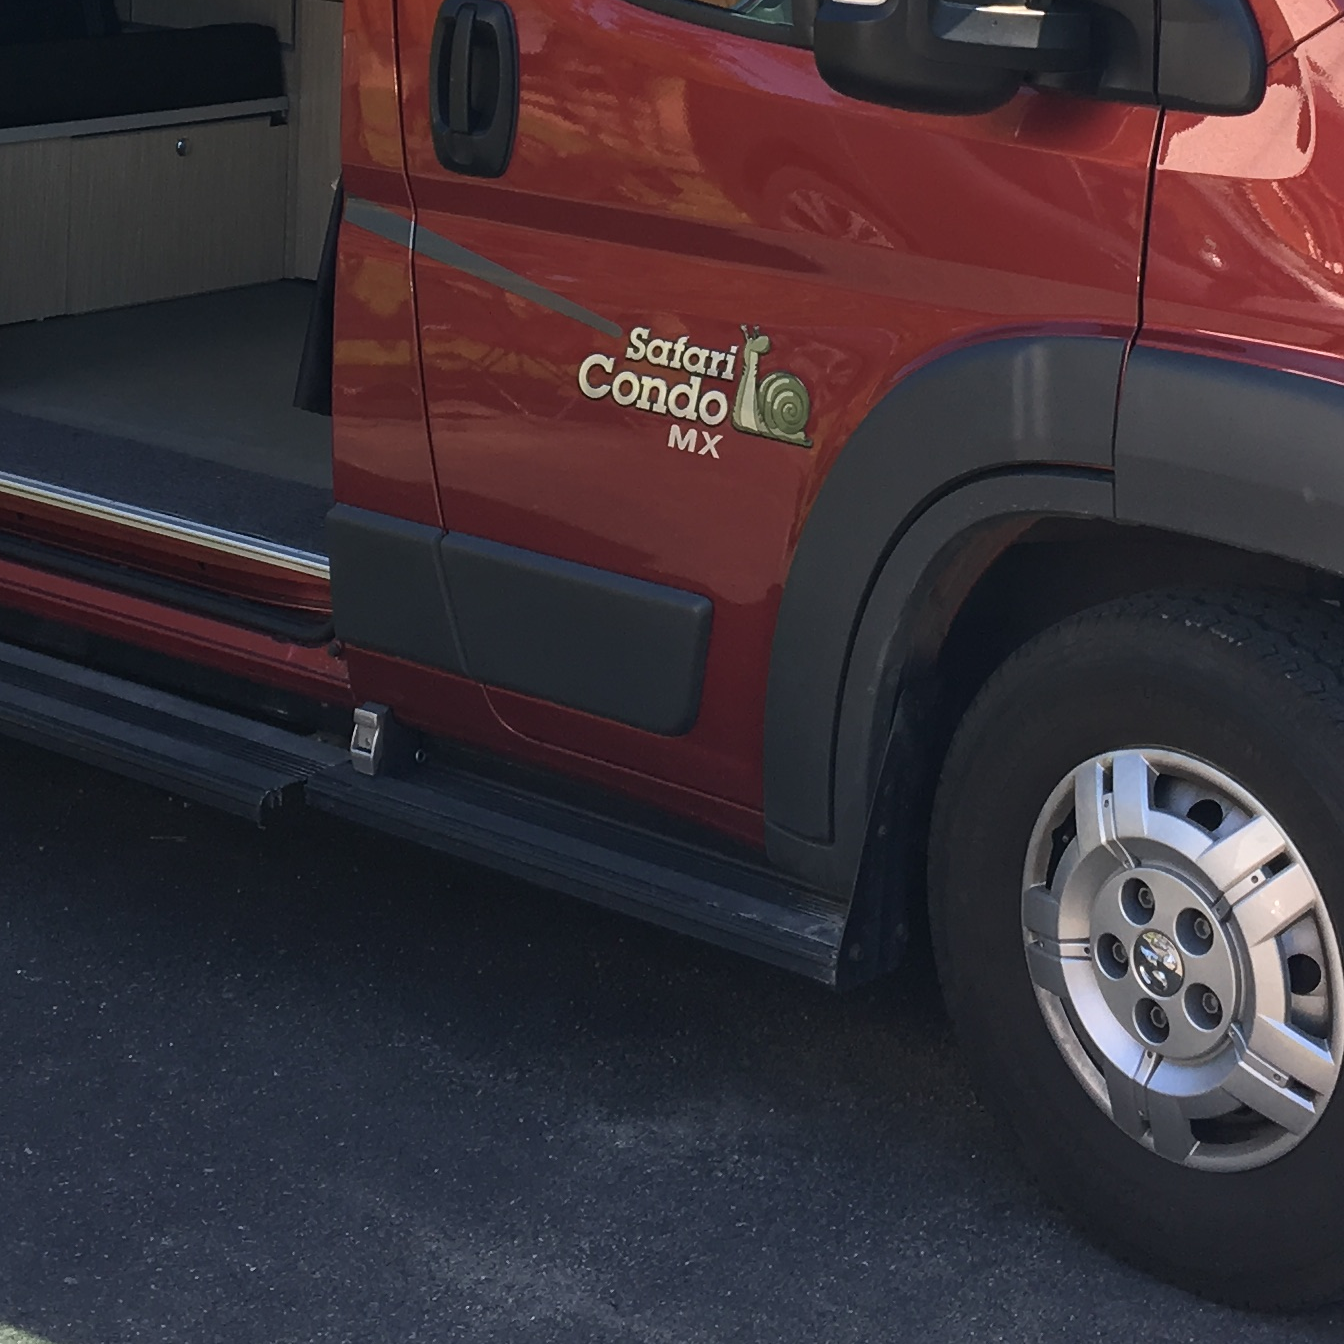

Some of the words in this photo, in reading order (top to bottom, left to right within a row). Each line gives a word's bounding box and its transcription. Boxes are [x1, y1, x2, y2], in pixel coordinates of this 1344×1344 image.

[625, 327, 738, 381] Safari
[578, 354, 729, 426] Condo
[667, 424, 724, 459] MX
